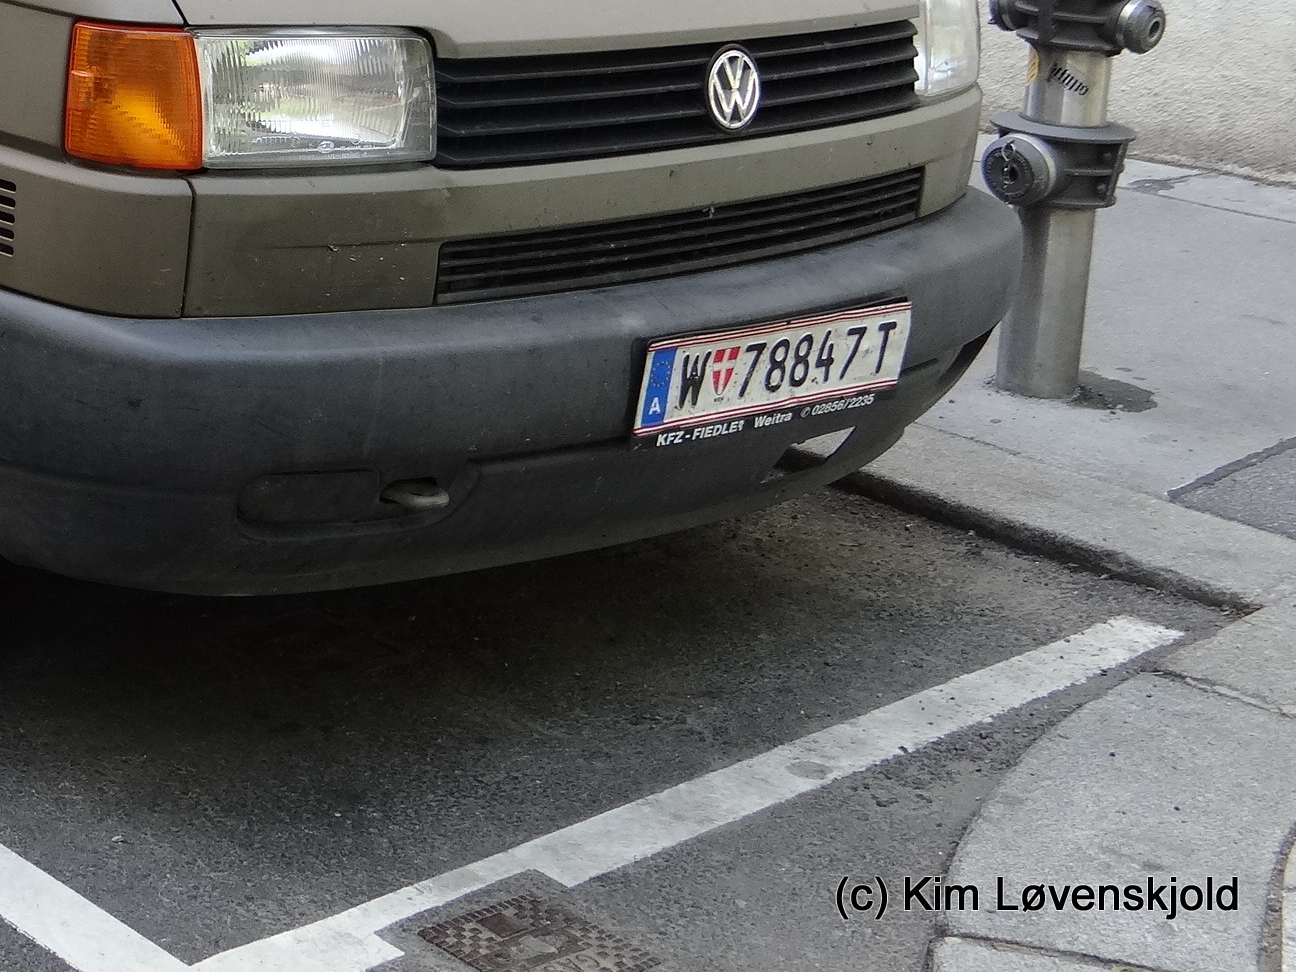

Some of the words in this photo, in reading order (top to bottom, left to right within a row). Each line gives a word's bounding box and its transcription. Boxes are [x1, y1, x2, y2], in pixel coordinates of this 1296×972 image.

[648, 396, 661, 415] A
[678, 349, 713, 410] W
[754, 411, 793, 428] Weitra
[811, 393, 876, 416] 02856/2235
